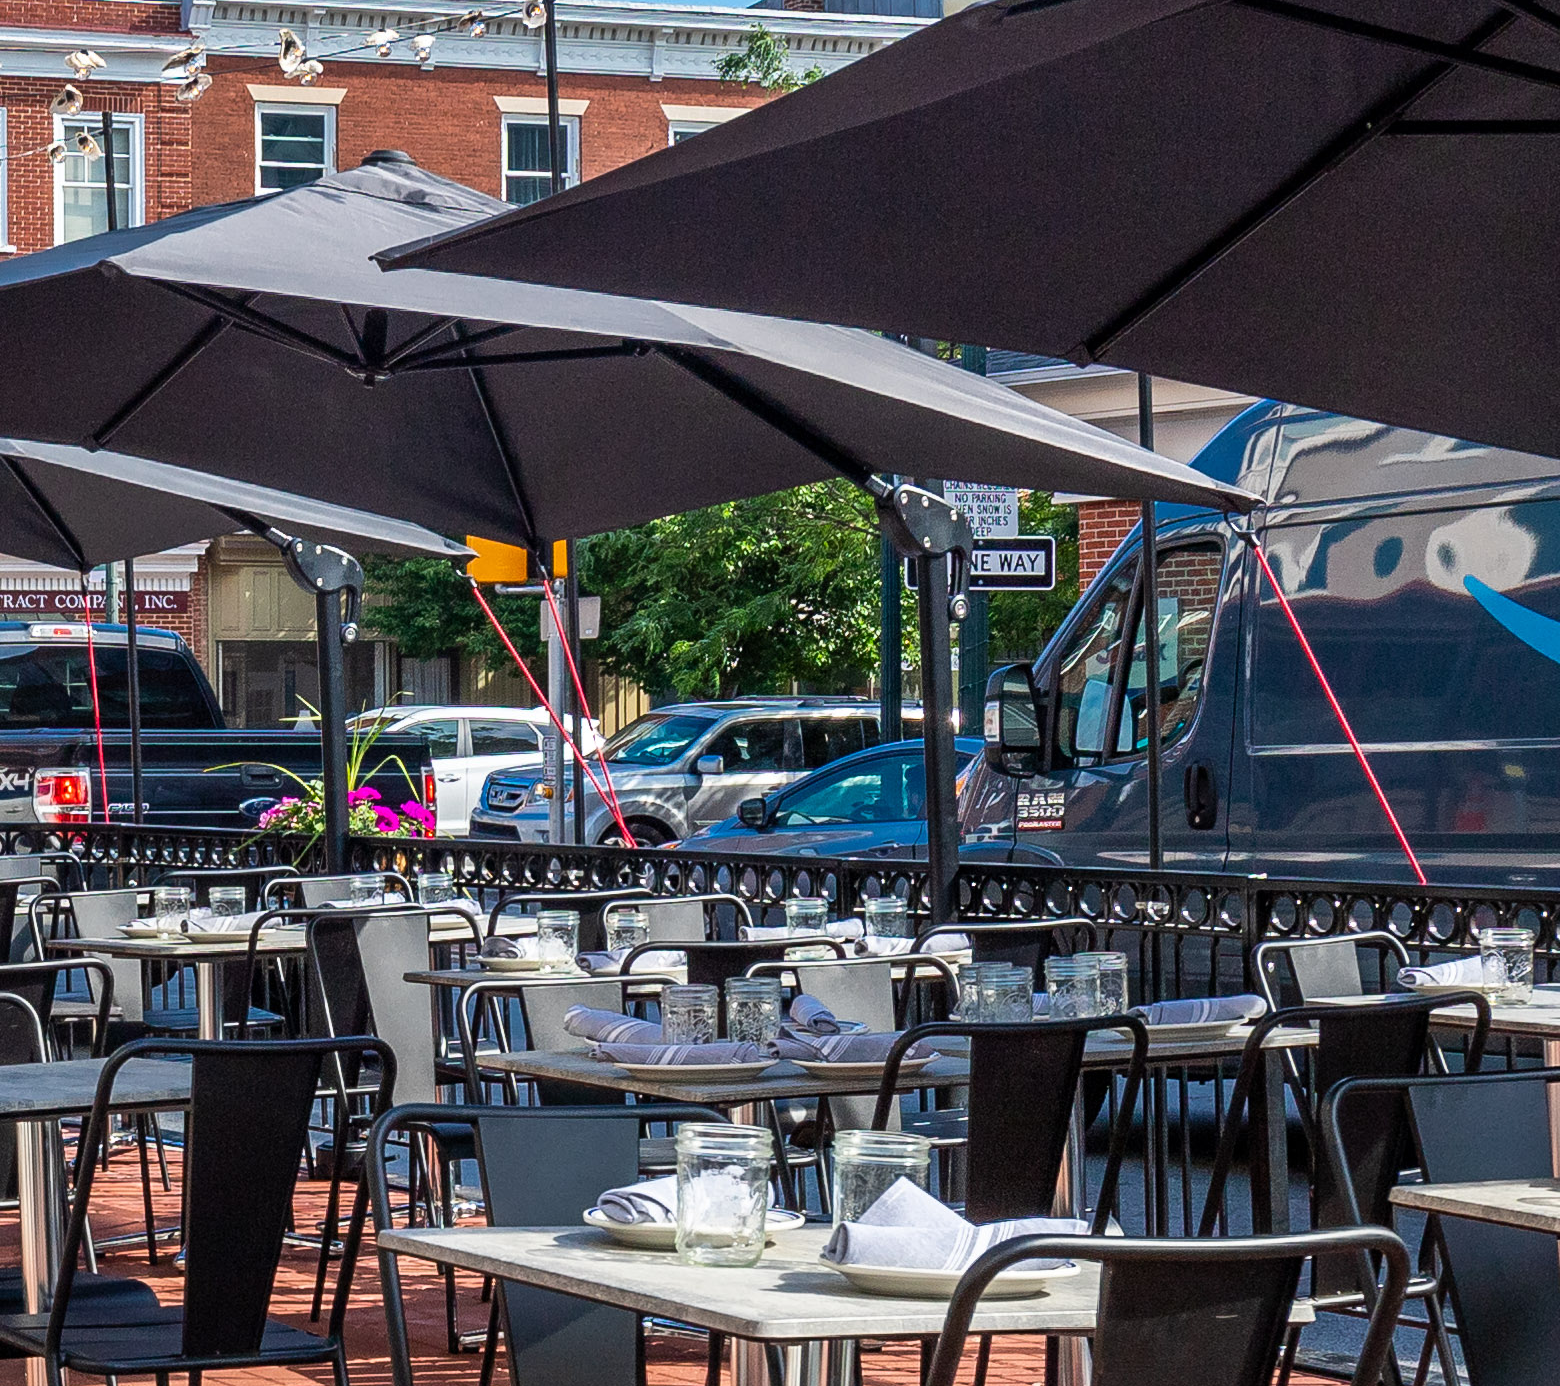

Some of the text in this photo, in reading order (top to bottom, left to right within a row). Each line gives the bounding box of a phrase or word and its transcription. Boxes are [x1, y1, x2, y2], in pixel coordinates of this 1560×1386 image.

[954, 493, 1007, 504] NO PARKING
[976, 504, 1000, 515] SNOW
[1003, 505, 1012, 515] IS
[977, 515, 1009, 526] INCHES
[971, 553, 1040, 573] NE WAY
[144, 594, 178, 610] INC.
[1017, 792, 1065, 806] RAM
[1017, 805, 1065, 819] 3500
